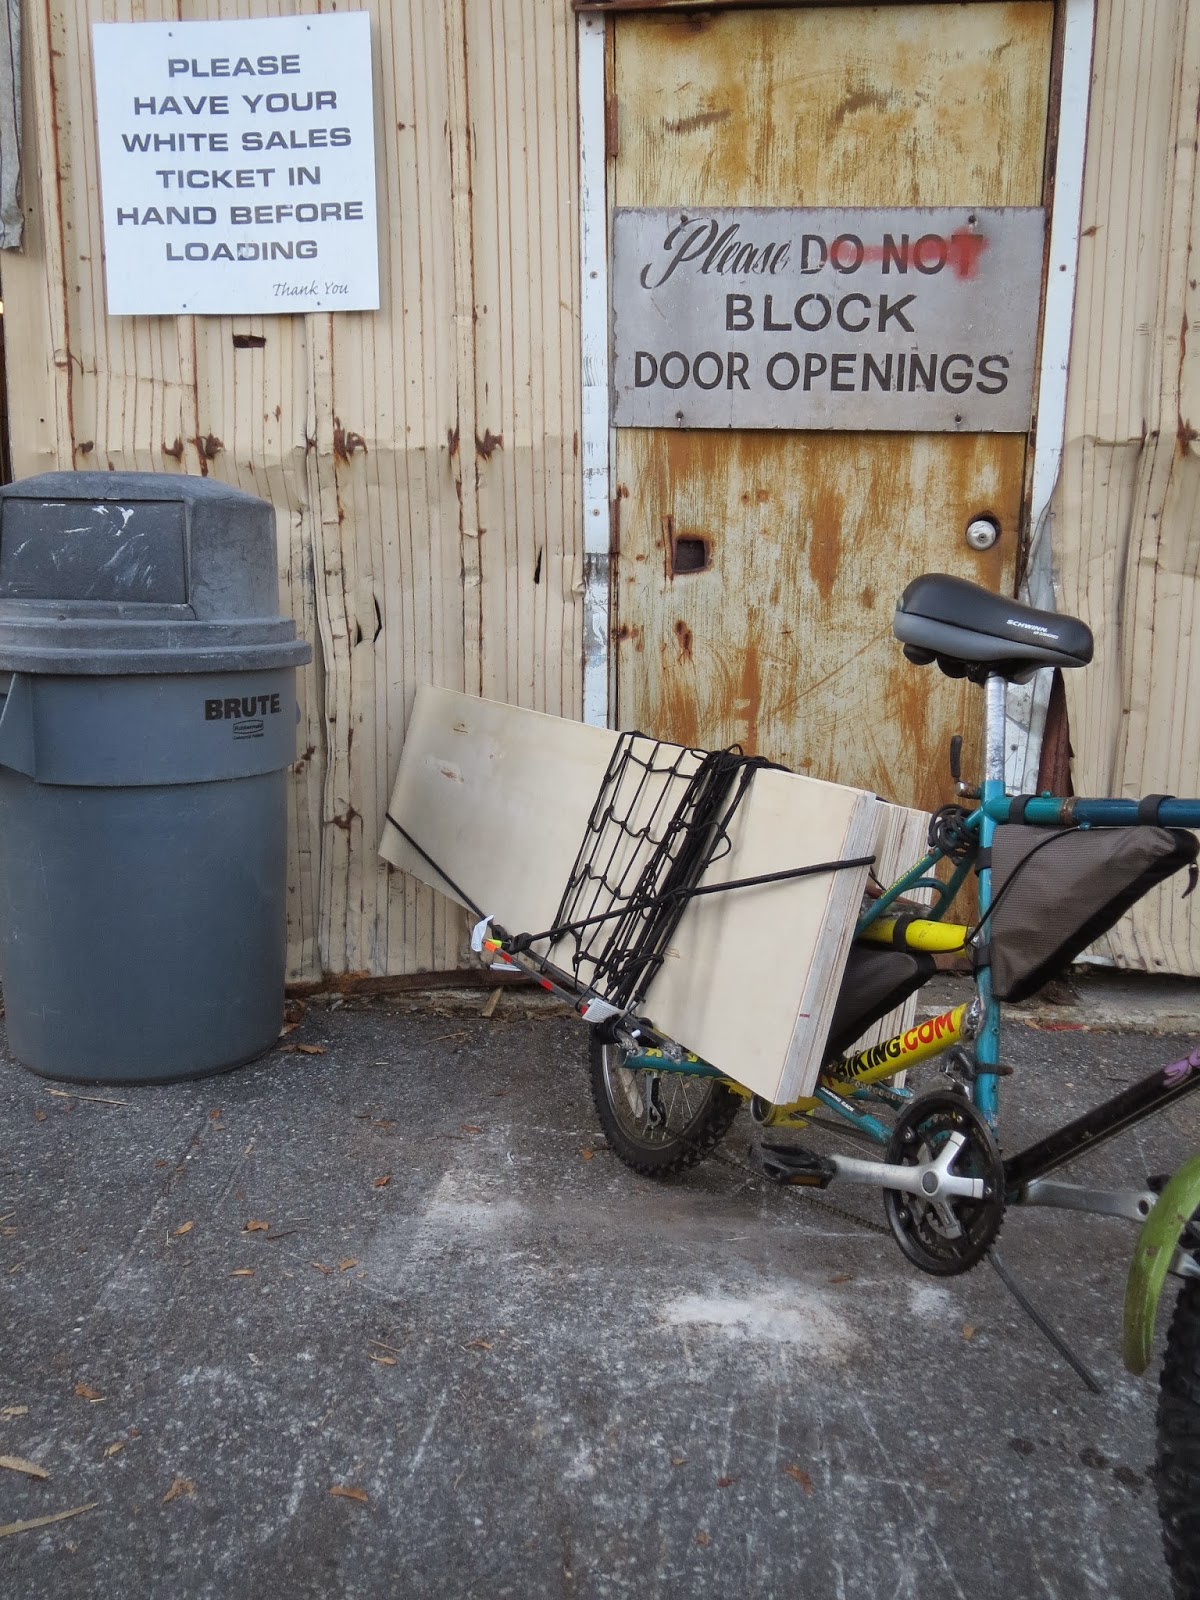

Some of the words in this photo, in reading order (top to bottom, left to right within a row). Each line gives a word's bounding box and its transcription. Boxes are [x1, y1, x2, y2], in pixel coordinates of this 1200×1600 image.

[168, 54, 301, 78] PLEASE
[133, 95, 229, 115] HAVE
[241, 90, 338, 114] YOUR
[121, 133, 229, 153] WHITE
[241, 127, 352, 151] SALES
[156, 168, 276, 189] TICKET
[288, 166, 321, 186] IN
[116, 206, 217, 226] HAND
[230, 201, 364, 226] BEFORE
[165, 240, 318, 261] LOADING
[640, 217, 792, 289] Please
[800, 233, 864, 275] DO
[881, 233, 984, 276] NOT
[272, 280, 319, 297] Thank
[324, 281, 349, 296] You
[725, 293, 918, 333] BLOCK
[634, 351, 751, 391] DOOR
[766, 351, 1010, 395] OPENINGS
[1006, 619, 1048, 633] SCHWINN
[204, 693, 280, 721] BRUTE
